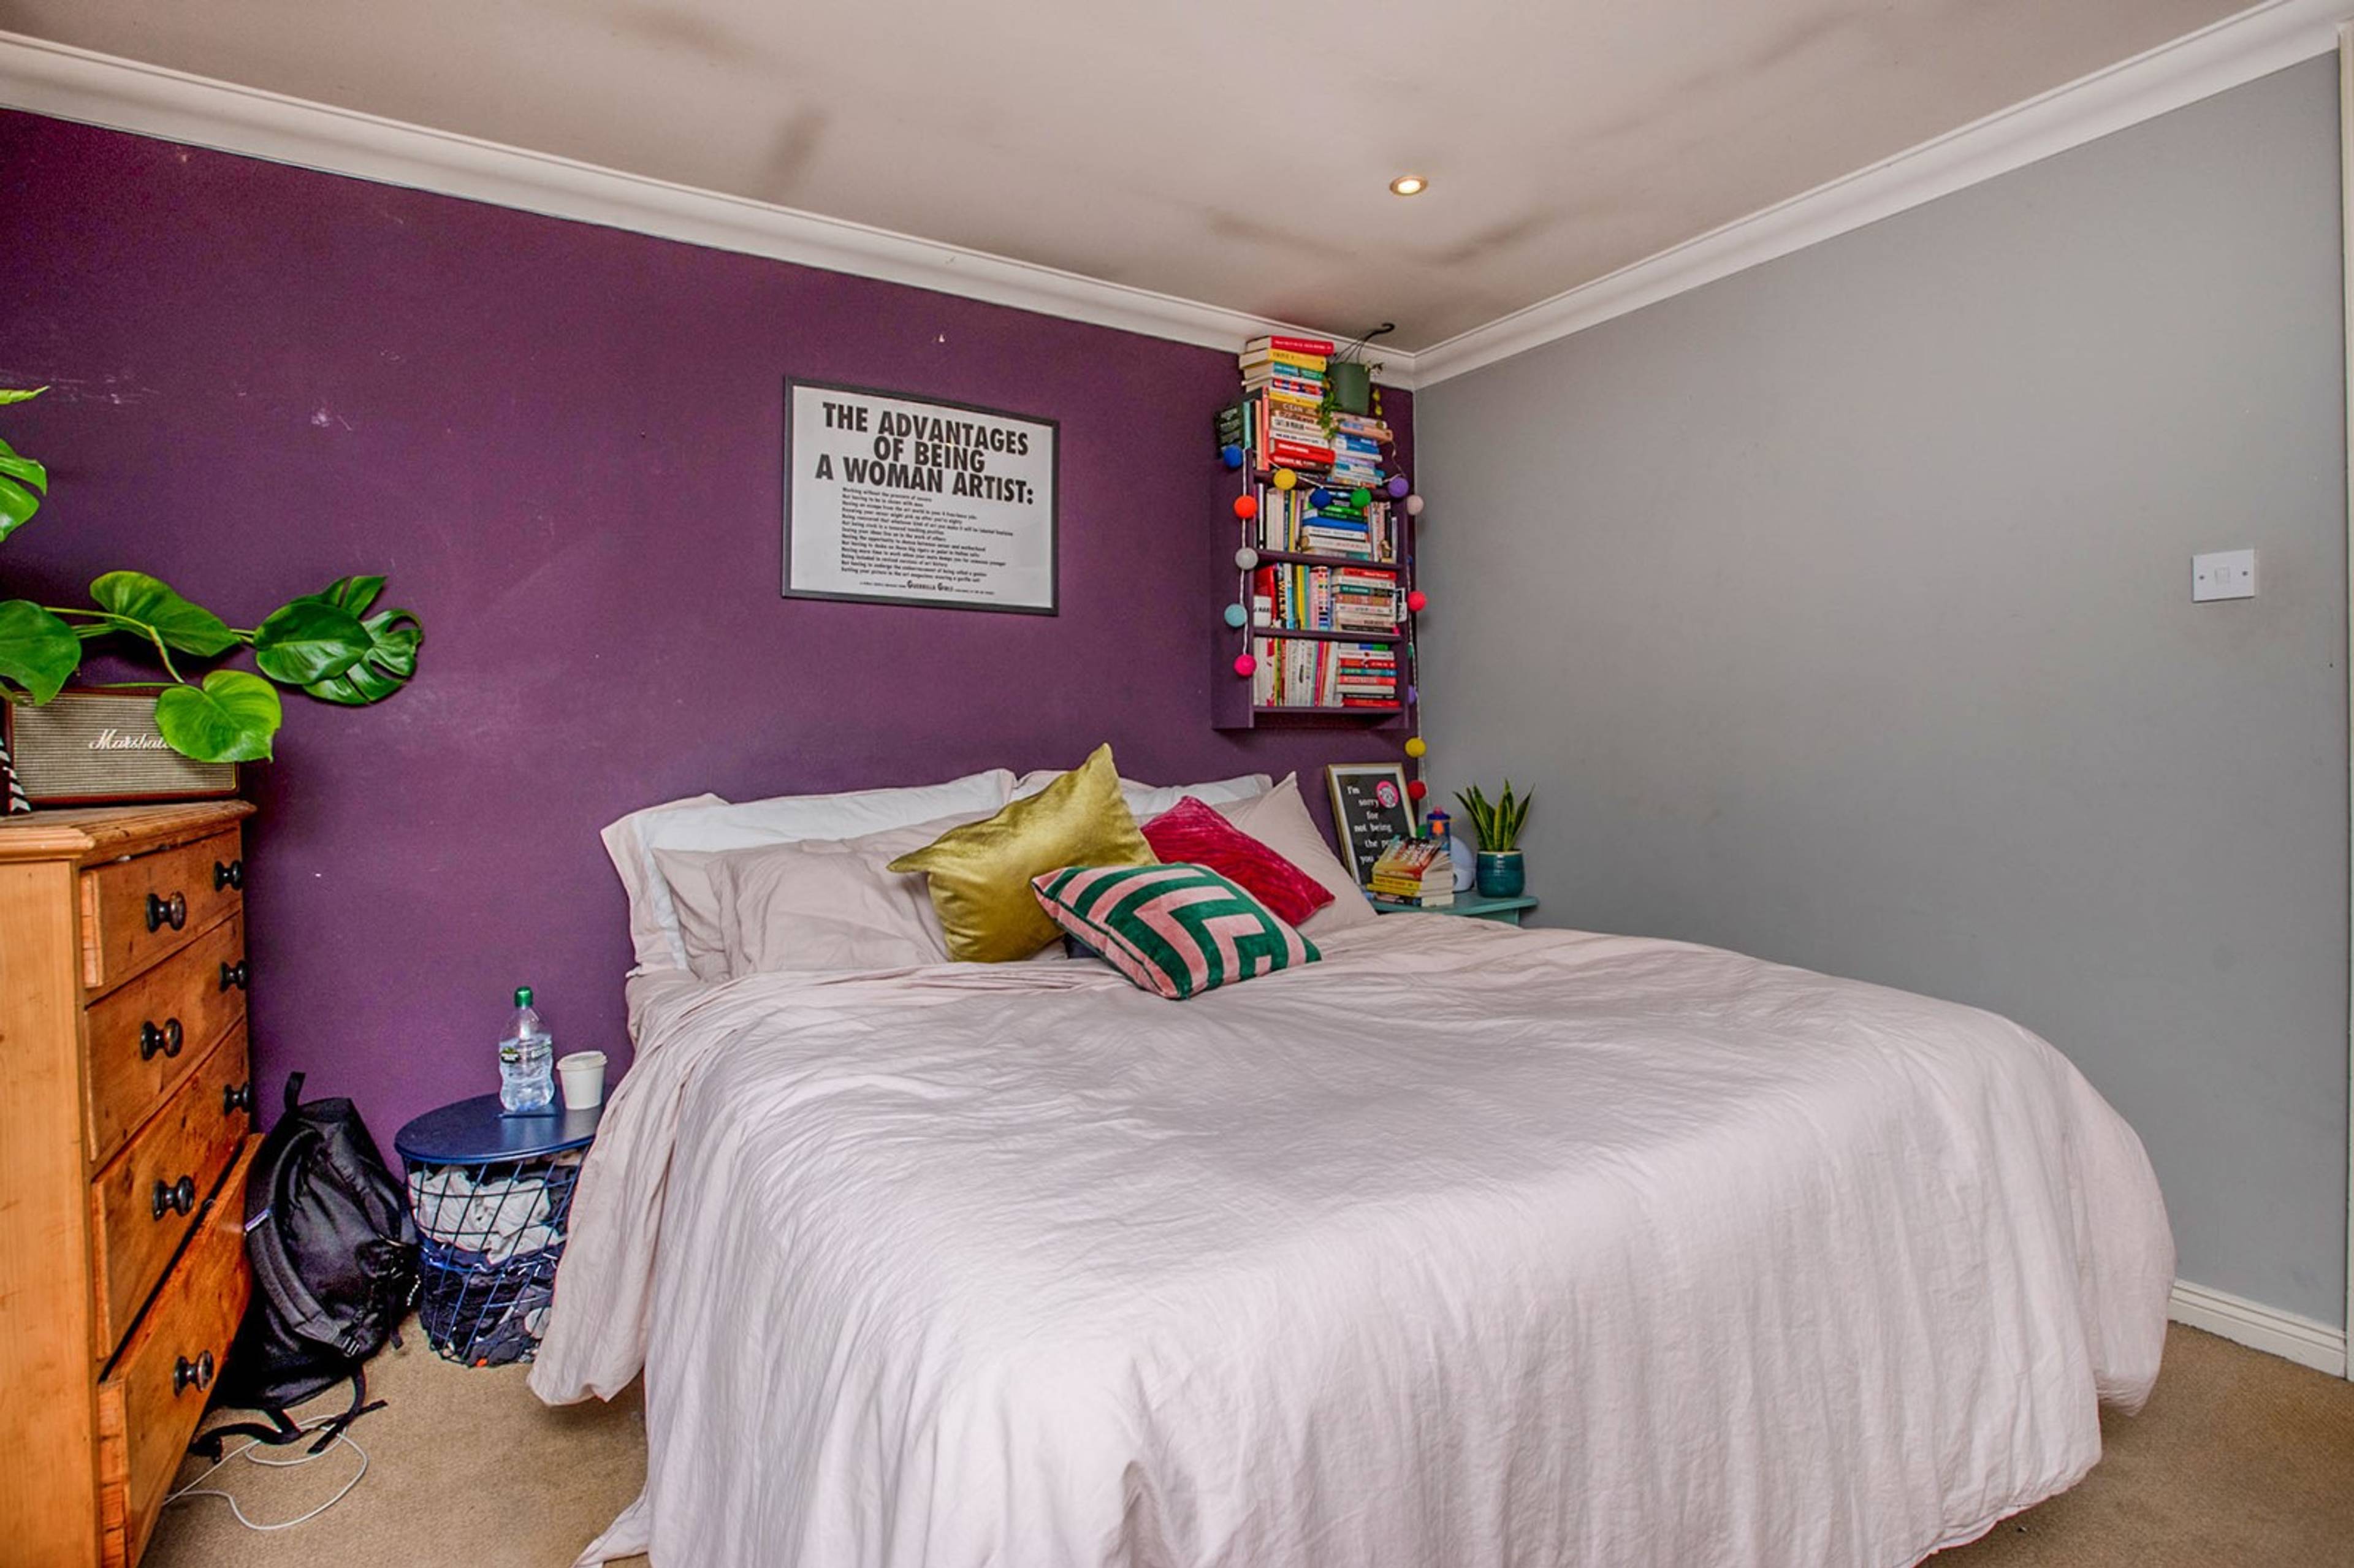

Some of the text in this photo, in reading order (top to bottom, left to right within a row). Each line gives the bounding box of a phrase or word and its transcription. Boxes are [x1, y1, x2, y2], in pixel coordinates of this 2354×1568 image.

[823, 402, 1028, 455] THE ADVANTAGES
[874, 435, 985, 473] OF BEING
[815, 453, 1034, 505] A WOMAN ARTIST:
[88, 728, 169, 750] Marshal
